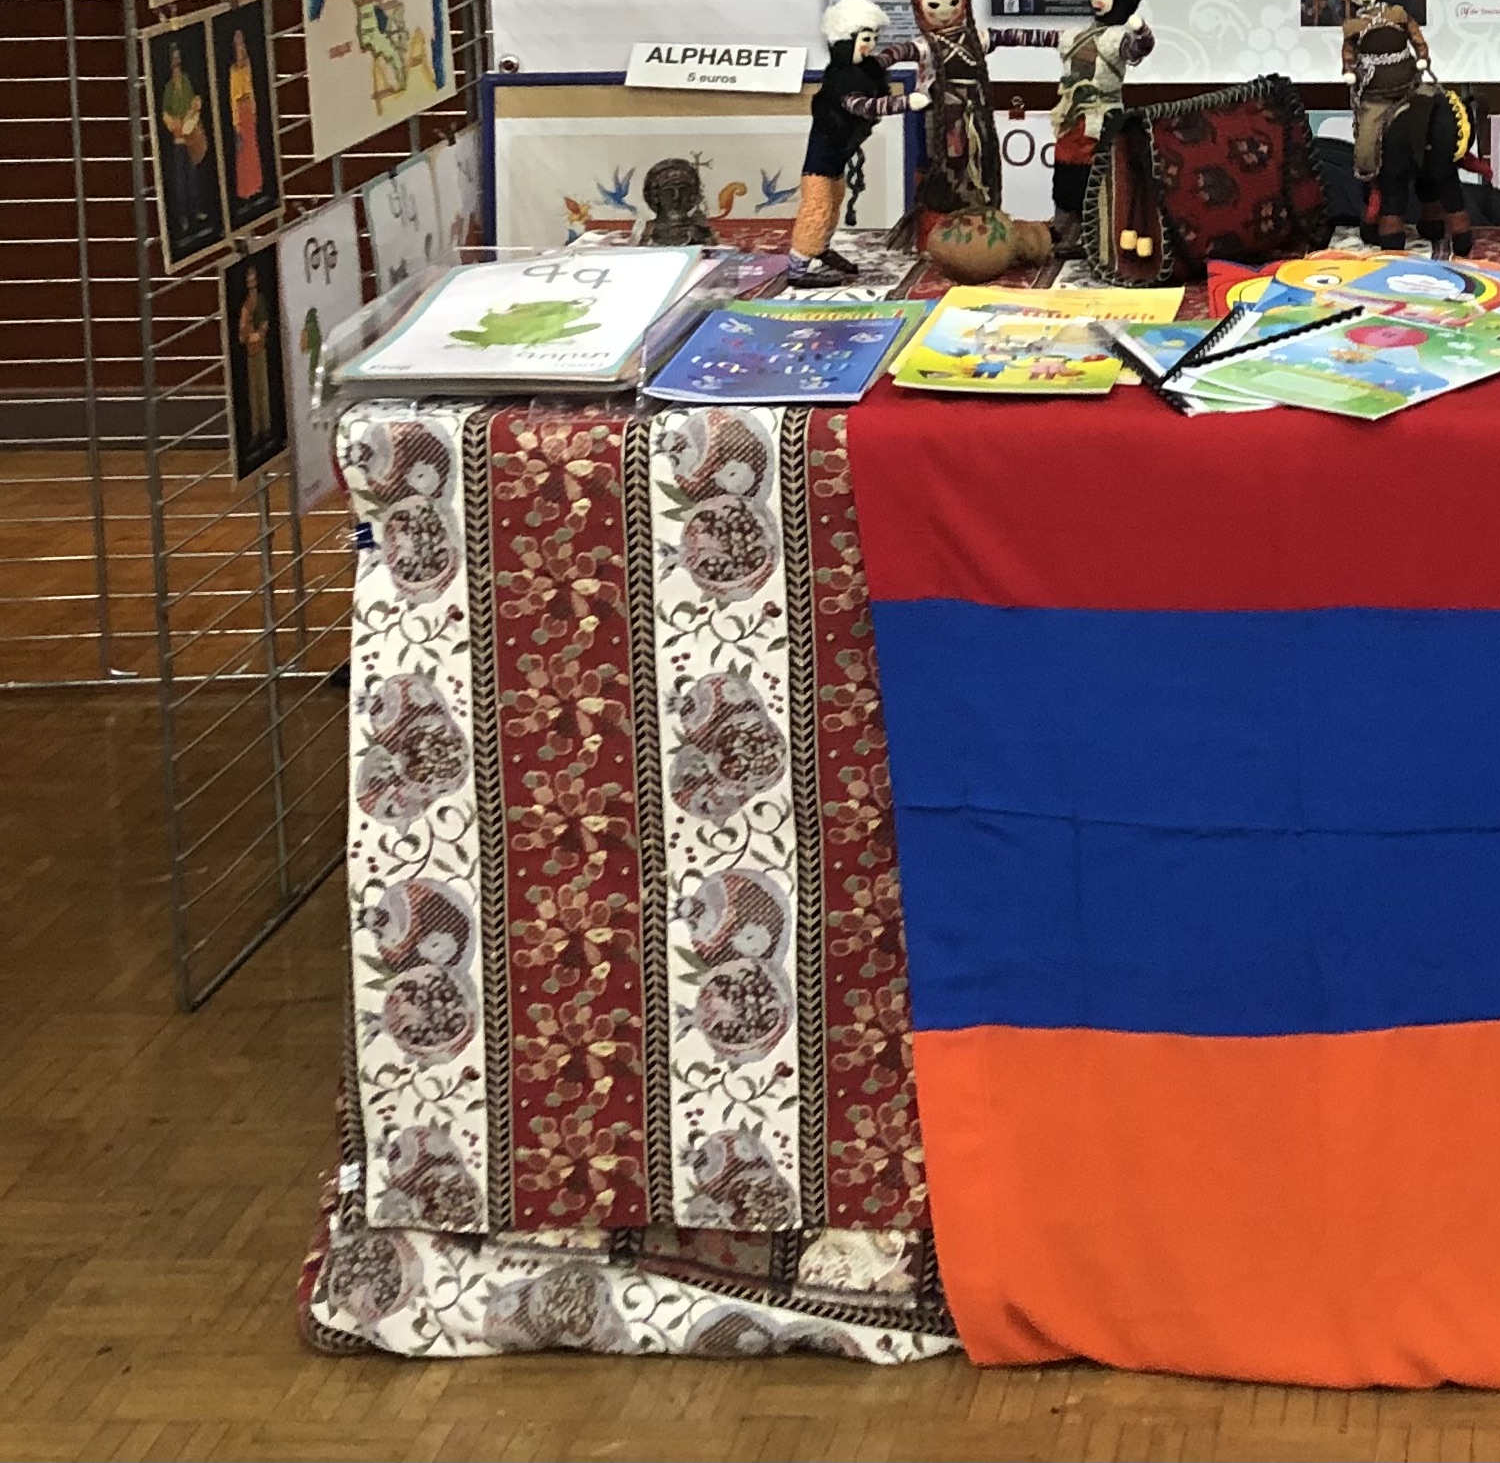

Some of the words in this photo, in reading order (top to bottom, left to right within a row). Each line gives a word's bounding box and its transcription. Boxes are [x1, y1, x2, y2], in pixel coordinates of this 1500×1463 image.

[645, 45, 788, 69] ALPHABET
[686, 72, 697, 84] 5
[699, 74, 737, 85] euros
